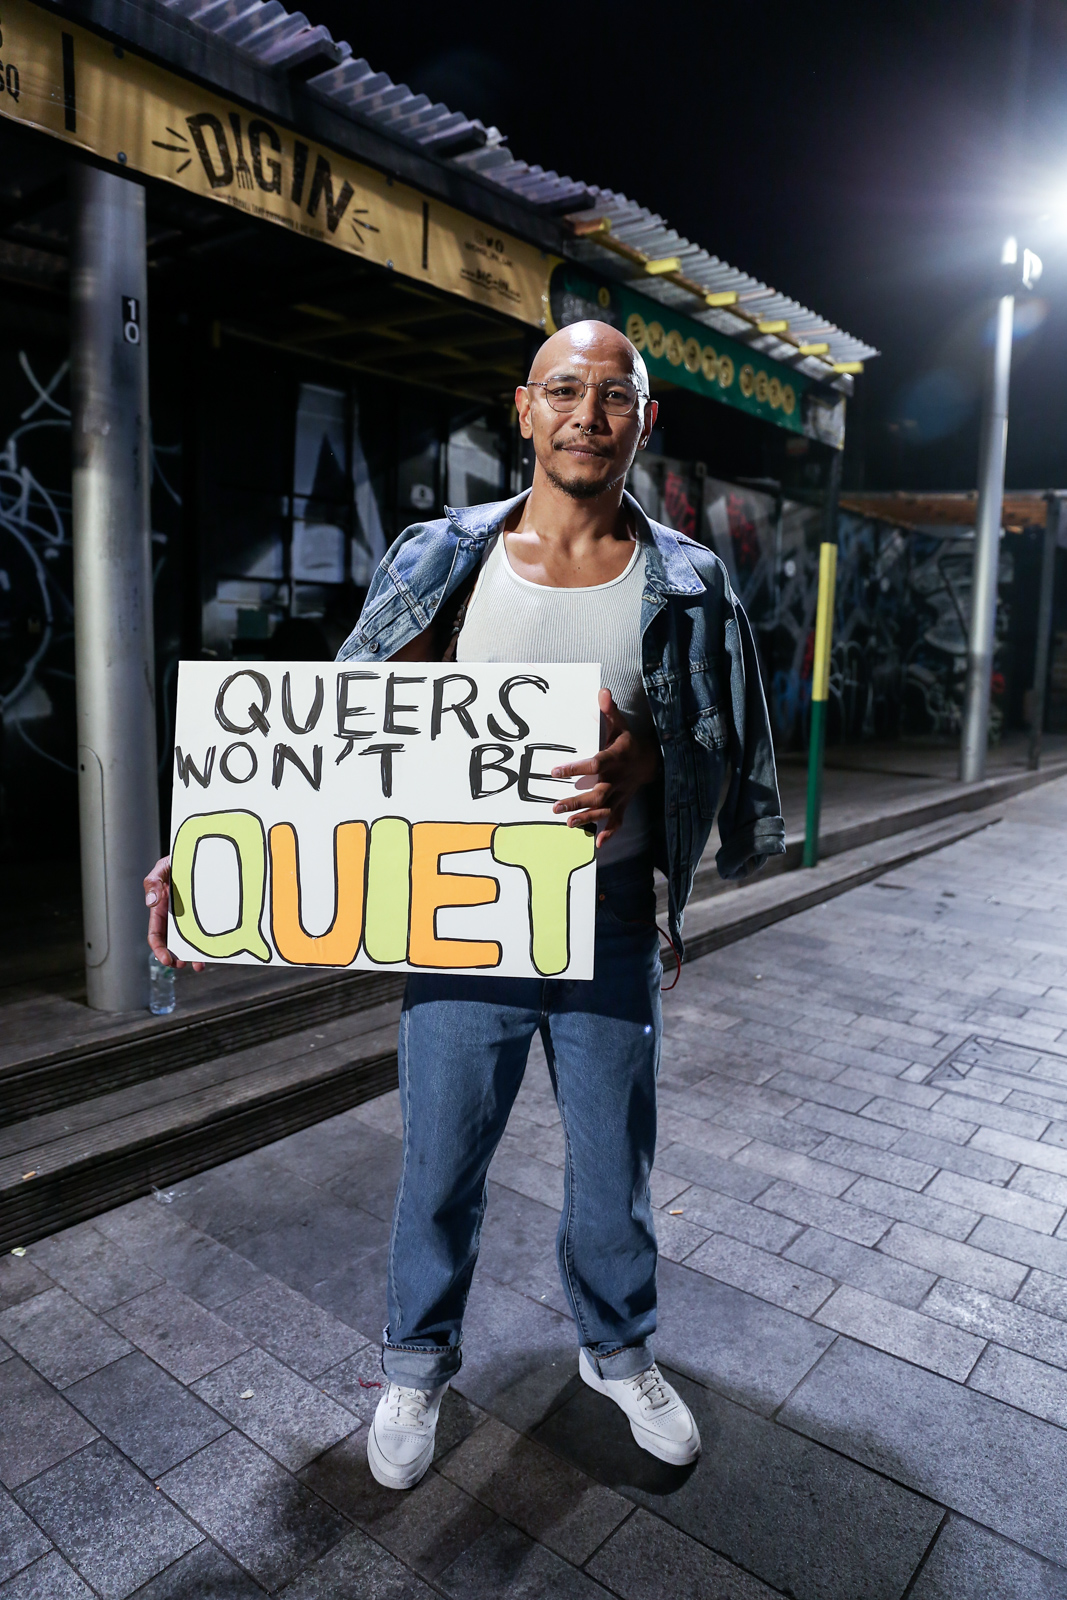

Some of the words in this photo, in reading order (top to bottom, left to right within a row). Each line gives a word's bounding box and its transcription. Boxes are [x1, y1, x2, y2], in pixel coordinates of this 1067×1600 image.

[214, 669, 550, 742] QUEERS
[175, 739, 406, 799] WON'T
[469, 743, 578, 803] BE
[170, 808, 598, 977] QUIET
